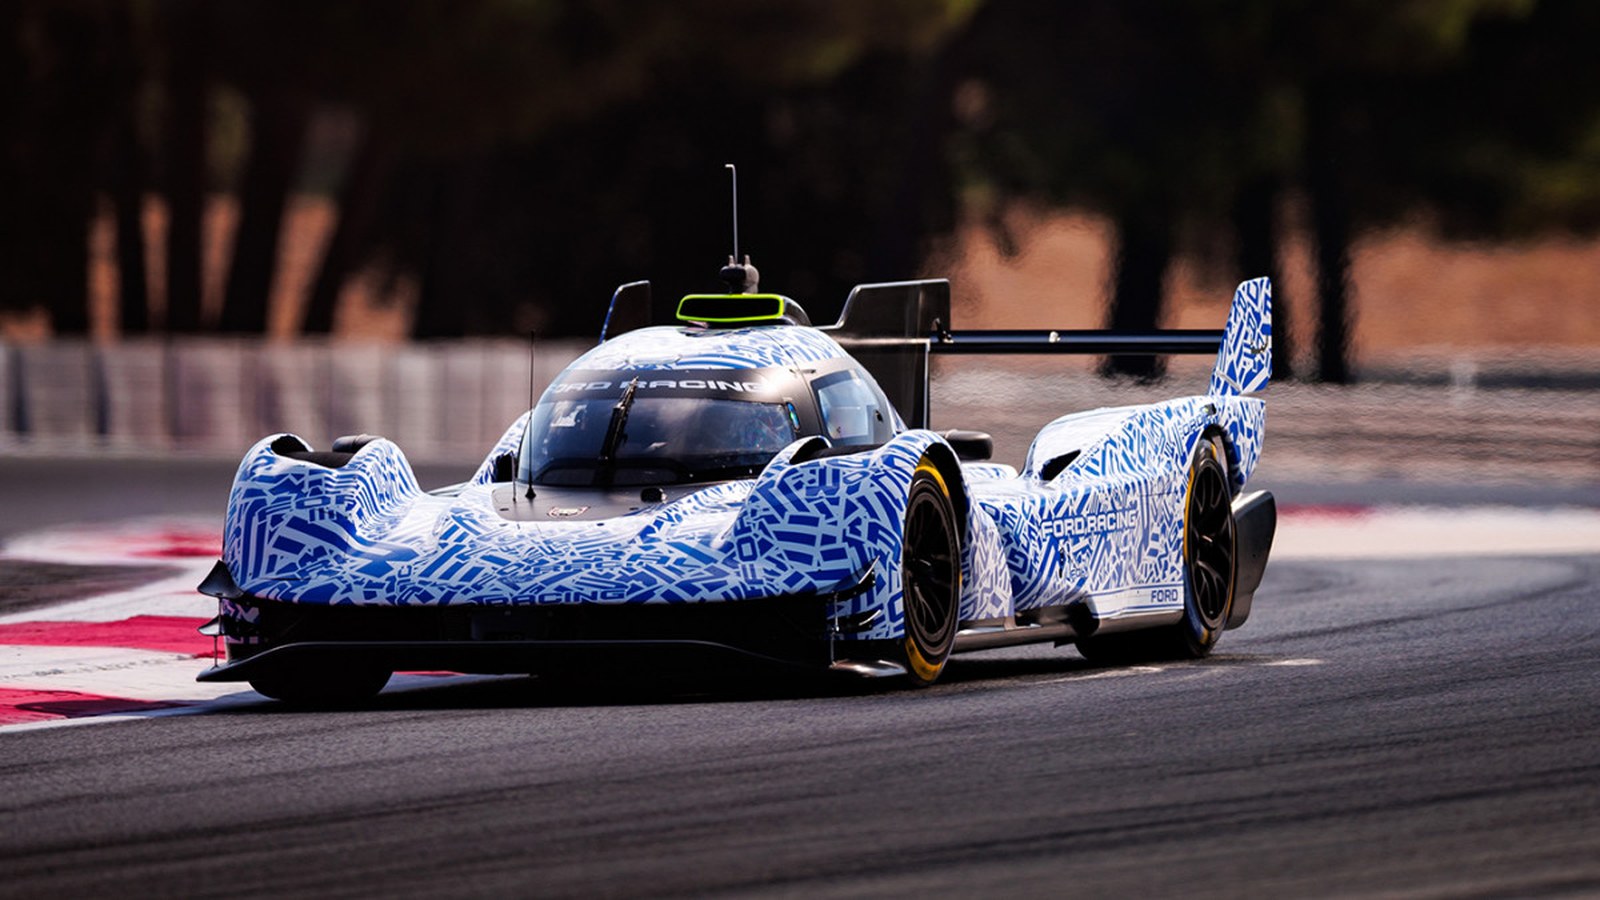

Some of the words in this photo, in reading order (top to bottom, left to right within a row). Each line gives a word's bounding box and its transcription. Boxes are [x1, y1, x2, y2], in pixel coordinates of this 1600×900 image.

[551, 382, 612, 393] ORD
[620, 380, 764, 393] RACING
[1041, 516, 1085, 541] FORD
[1087, 510, 1138, 534] RACING
[1151, 589, 1178, 602] FORD
